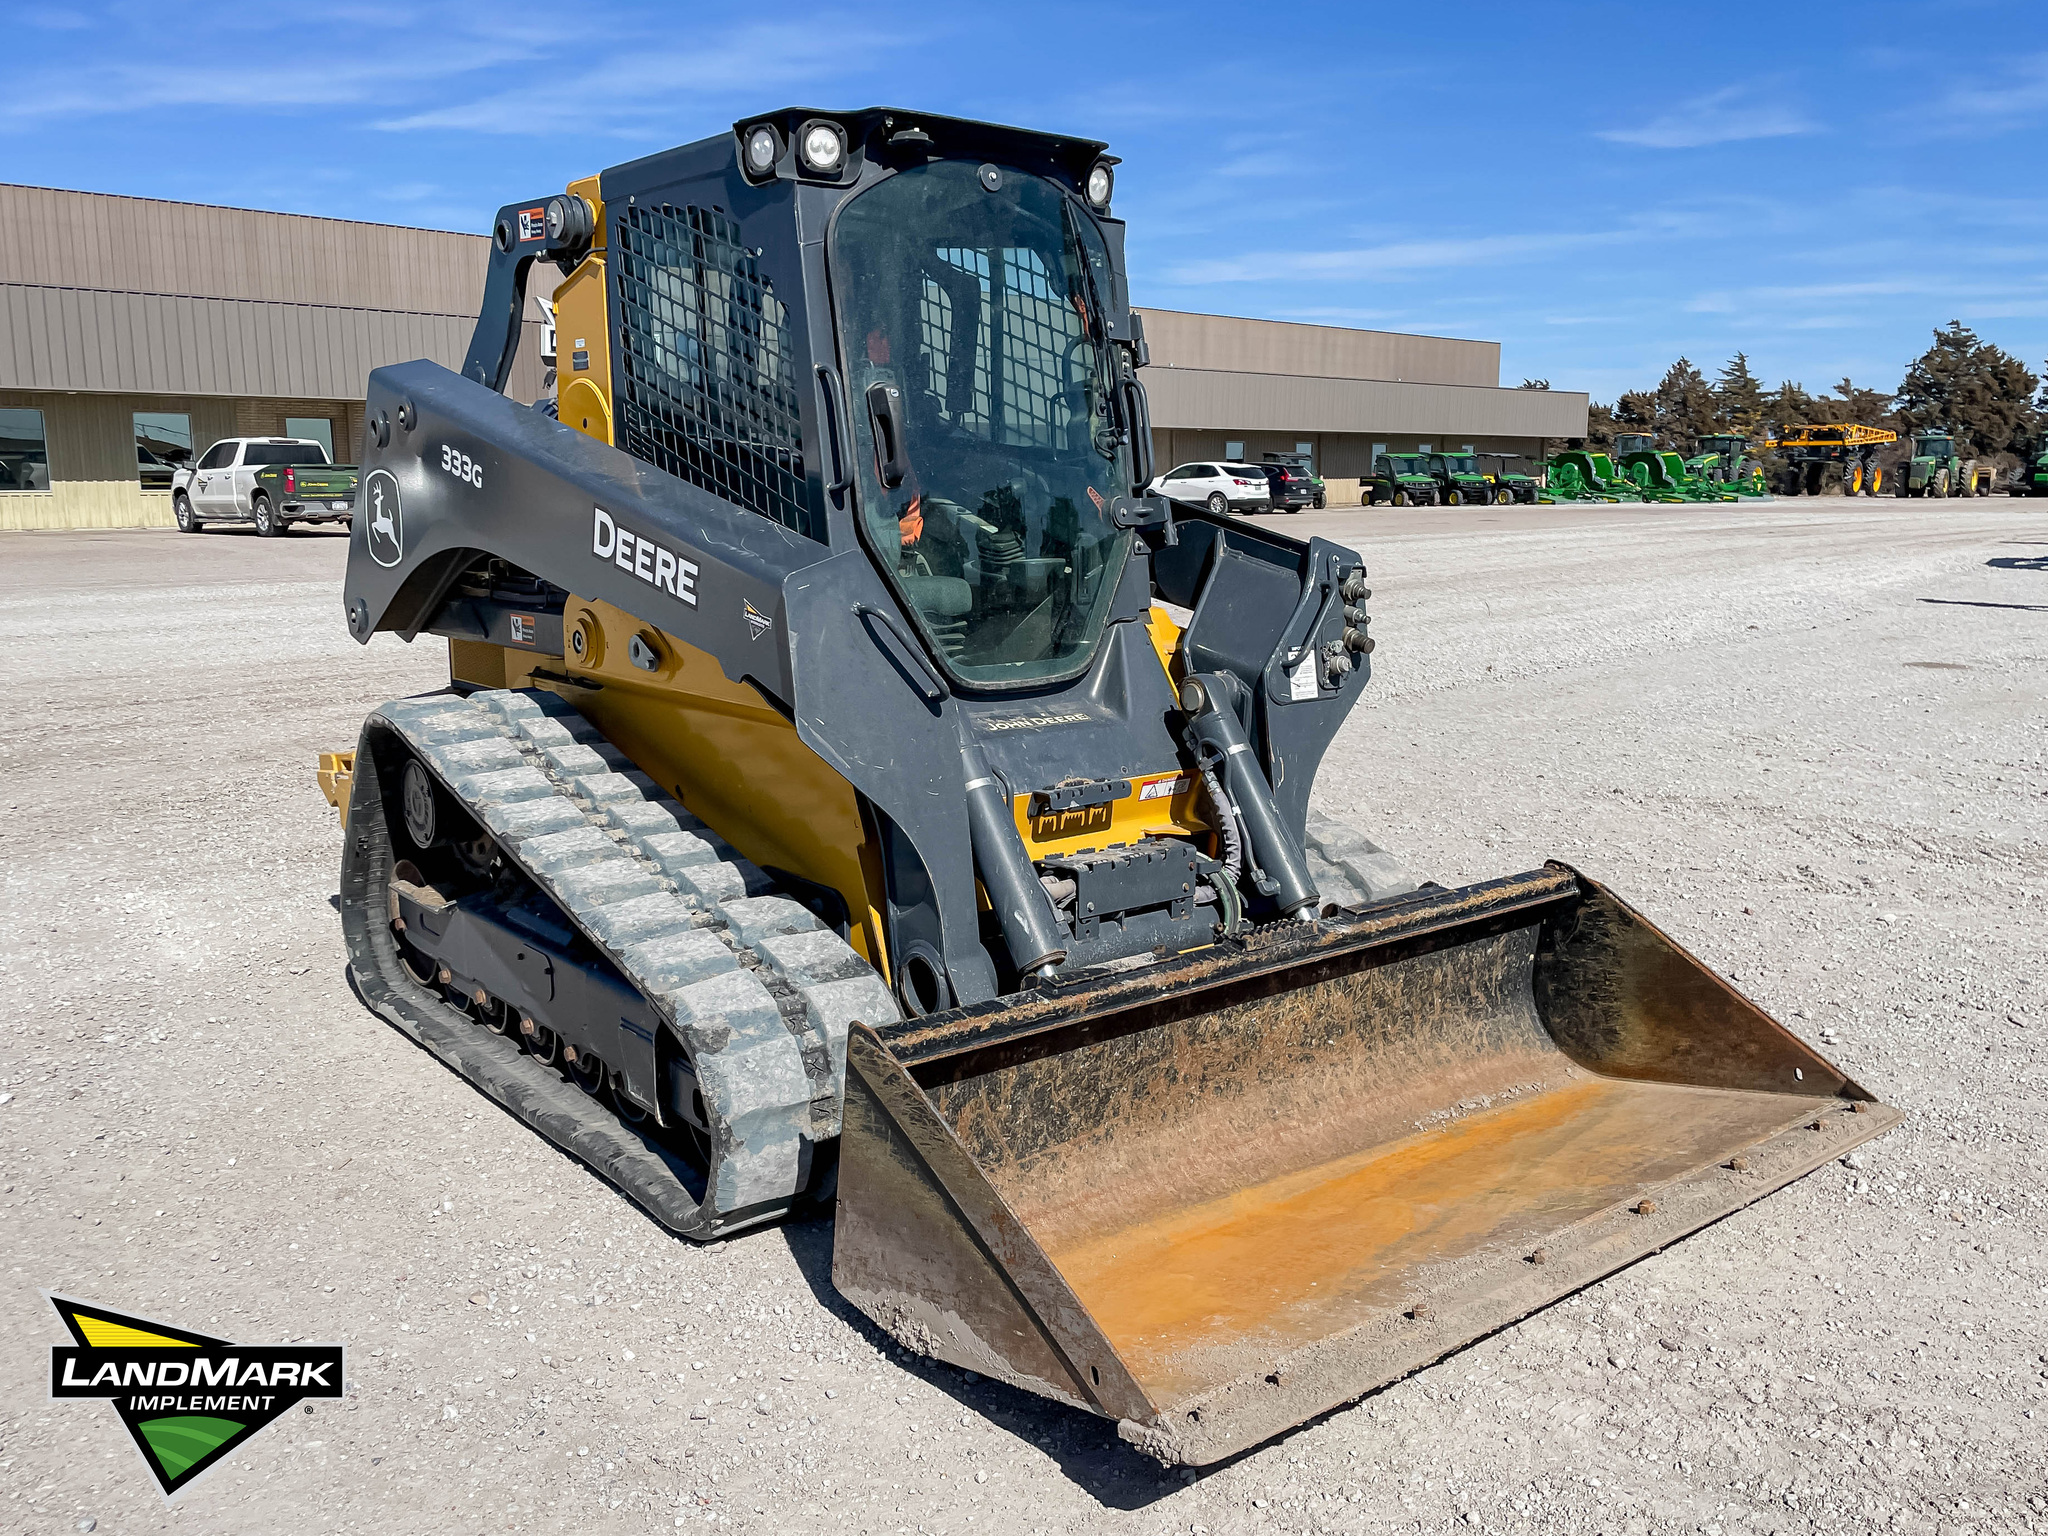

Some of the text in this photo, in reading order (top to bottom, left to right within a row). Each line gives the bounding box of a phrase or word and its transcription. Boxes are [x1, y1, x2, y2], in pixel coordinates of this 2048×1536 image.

[441, 444, 483, 488] 333G
[593, 507, 698, 605] DEERE
[987, 713, 1091, 731] JOHN DEERE
